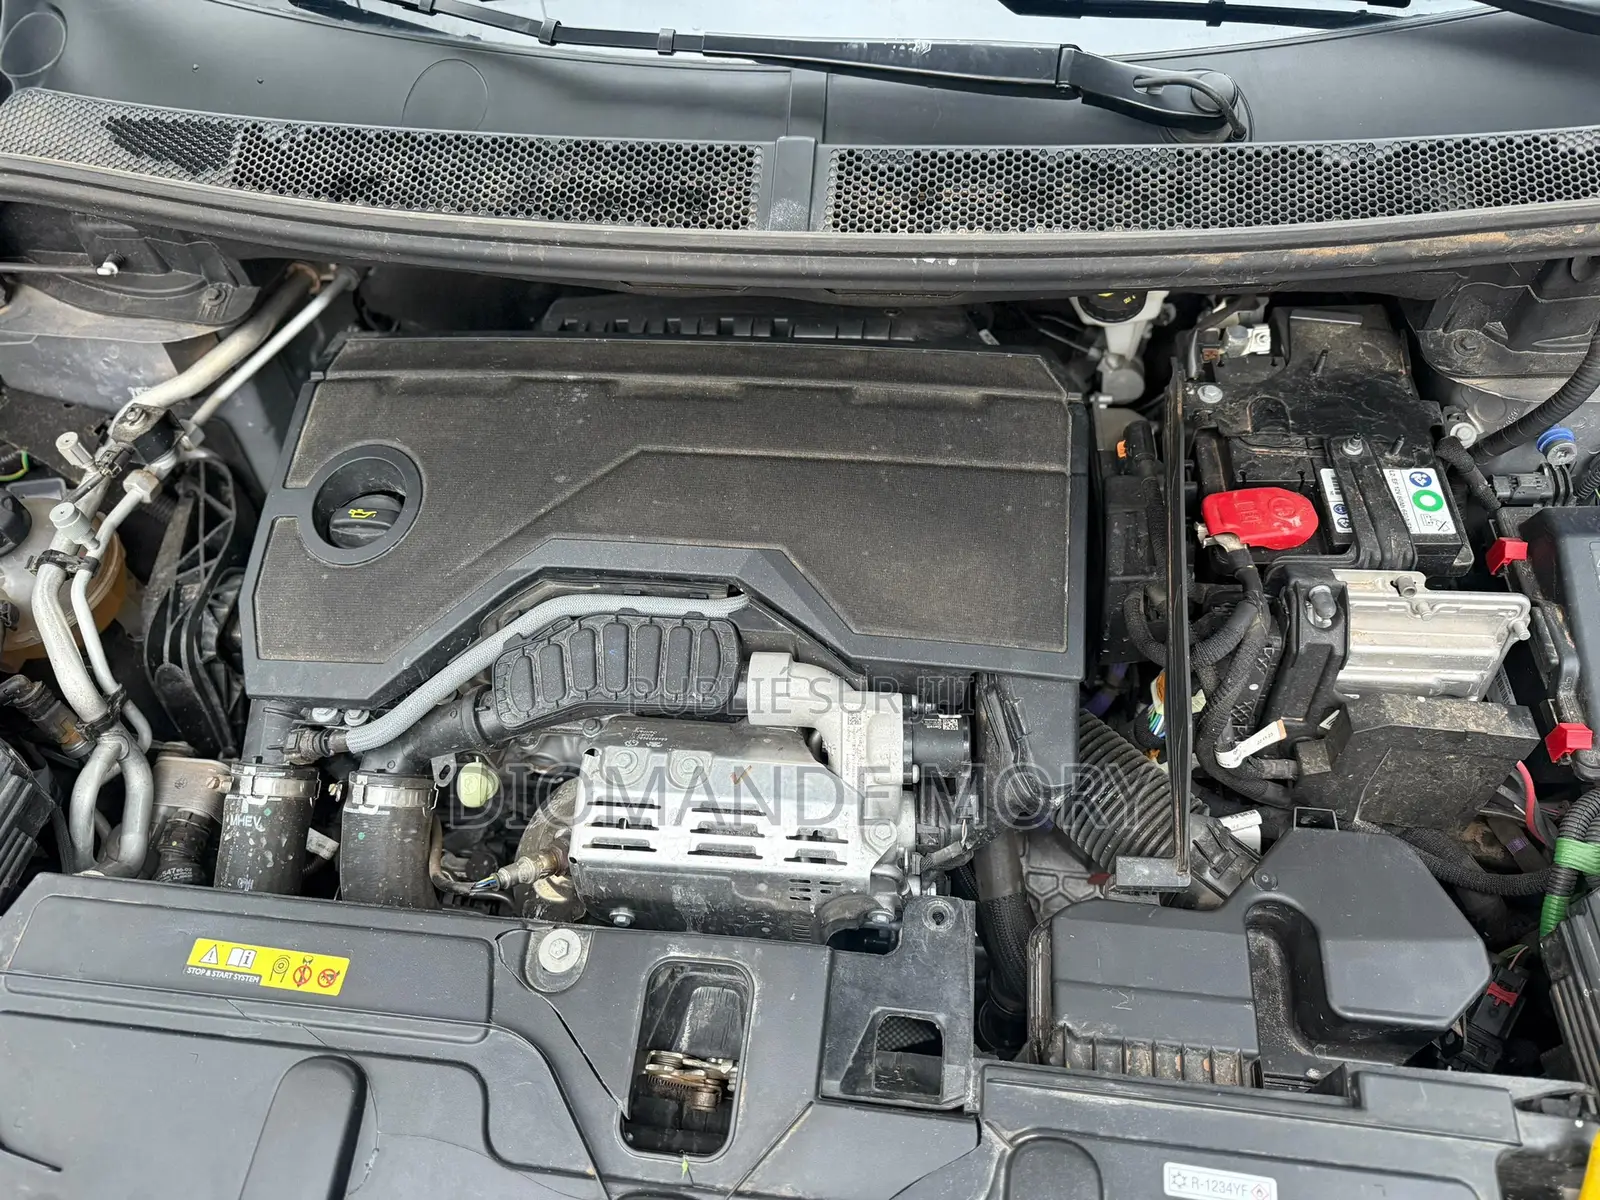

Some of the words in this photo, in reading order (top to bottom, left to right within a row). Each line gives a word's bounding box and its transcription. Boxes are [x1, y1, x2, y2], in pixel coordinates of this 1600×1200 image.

[230, 814, 261, 828] MHEV
[187, 967, 205, 975] STOP
[211, 970, 233, 979] START
[233, 973, 260, 983] SYSTEM
[1191, 1176, 1249, 1197] R-1234YF
